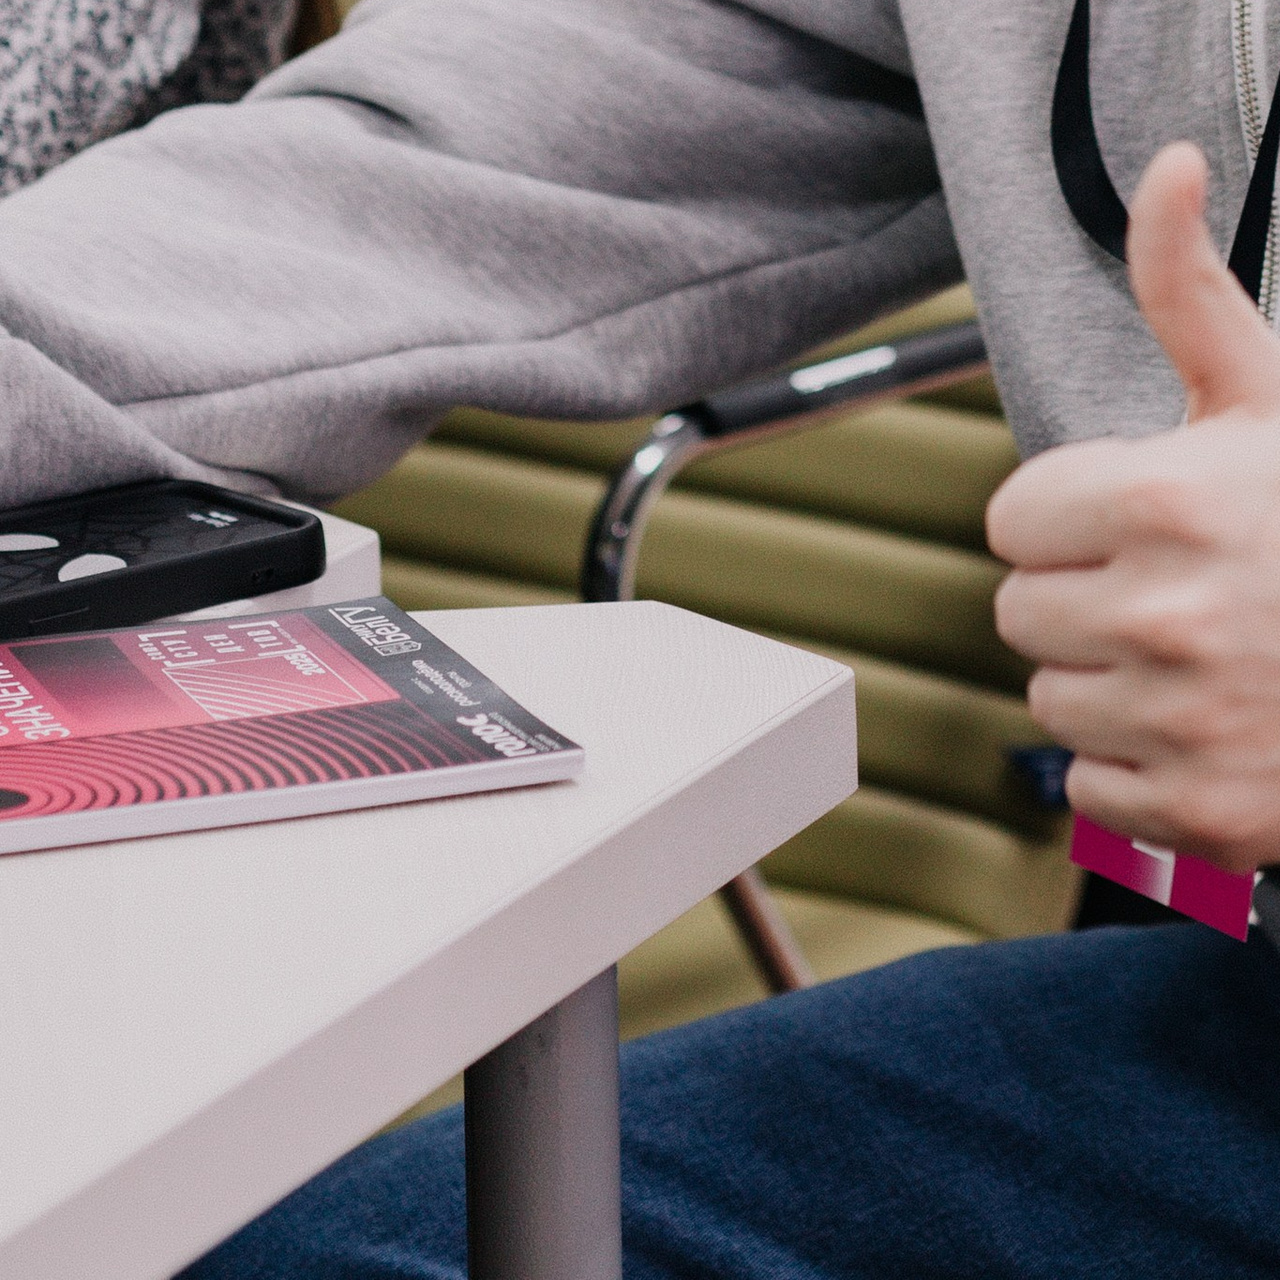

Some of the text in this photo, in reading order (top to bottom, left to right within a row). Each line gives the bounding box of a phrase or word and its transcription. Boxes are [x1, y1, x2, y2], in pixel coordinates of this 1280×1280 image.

[334, 607, 411, 646] БелГУ
[161, 640, 198, 658] СТУ
[203, 634, 245, 653] ДЕН
[247, 629, 283, 648] ТОВ
[283, 651, 326, 676] 2025
[0, 662, 71, 740] ЗНАЧЕ
